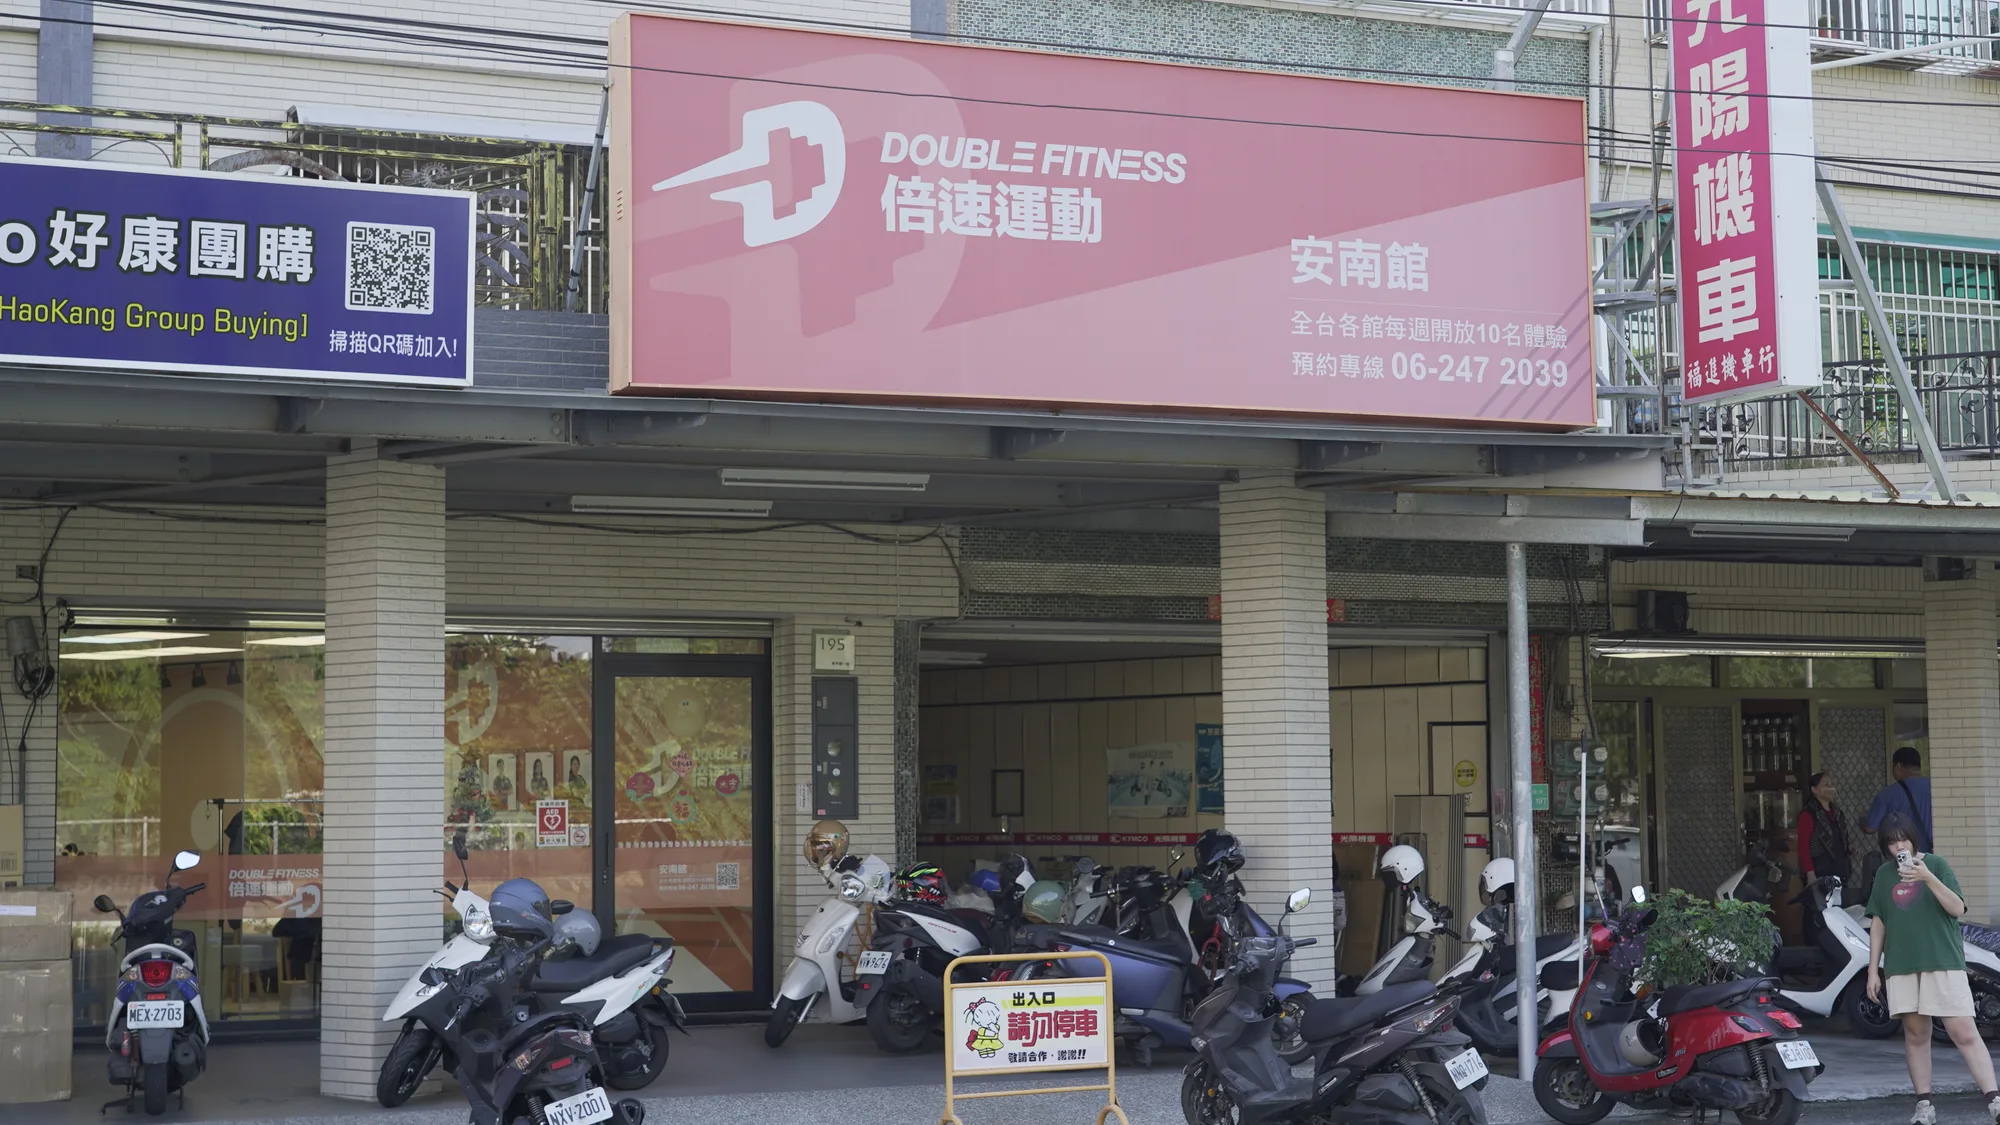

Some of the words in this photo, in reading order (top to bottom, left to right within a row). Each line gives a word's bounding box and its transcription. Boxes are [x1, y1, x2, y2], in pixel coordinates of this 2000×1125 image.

[880, 131, 1037, 173] DOUBLE
[1041, 143, 1187, 184] FITNESS
[881, 173, 1102, 244] 倍速運動
[49, 210, 315, 283] 好康團購
[1290, 234, 1430, 292] 安南館
[125, 303, 205, 337] Group
[214, 308, 309, 343] Buying]
[1290, 310, 1568, 350] 全台各館每週開放10名體驗
[329, 329, 458, 359] 掃描QR碼加入!
[1291, 351, 1385, 380] 預約專線
[1391, 351, 1490, 384] 06-247
[1499, 357, 1568, 388] 2039
[820, 637, 845, 651] 195
[228, 880, 294, 898] 倍速運動
[229, 869, 275, 880] DOUBLE
[275, 868, 320, 879] FITNESS
[129, 1007, 182, 1022] MEX-2703
[1012, 991, 1056, 1007] 出入口
[1007, 1009, 1099, 1048] 請勿停車
